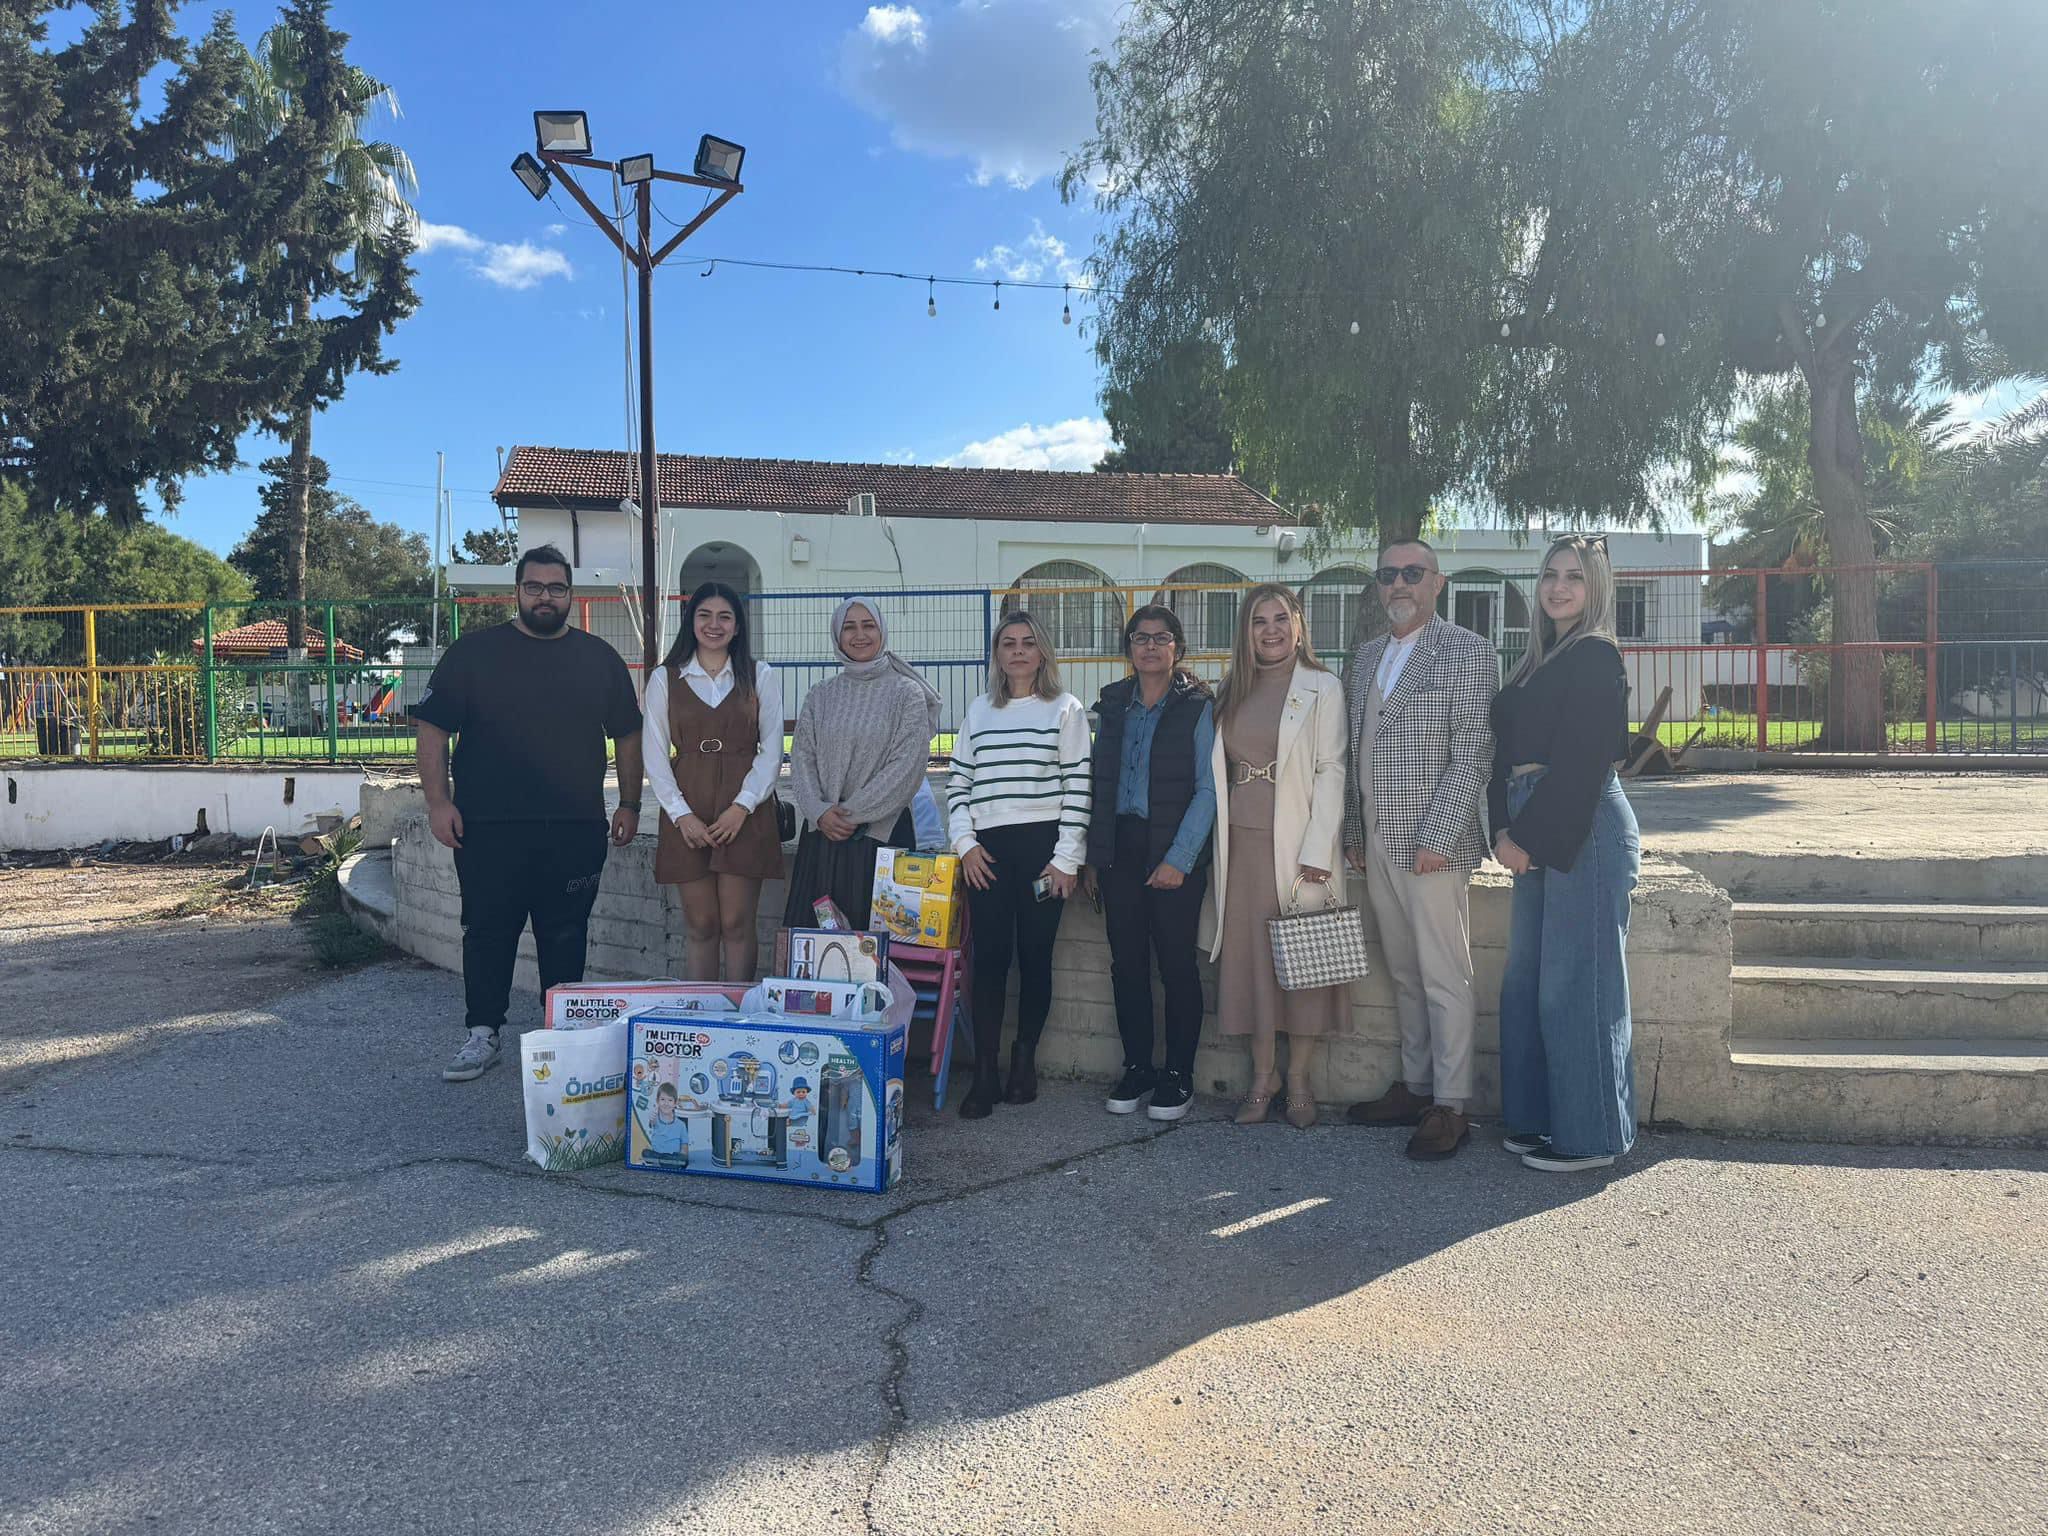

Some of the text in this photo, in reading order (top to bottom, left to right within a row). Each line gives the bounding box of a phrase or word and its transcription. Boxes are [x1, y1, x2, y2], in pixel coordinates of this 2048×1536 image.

[567, 999, 578, 1007] I'M
[581, 999, 613, 1007] LITTLE
[567, 1008, 619, 1018] DOCTOR
[646, 1030, 658, 1039] I'M
[661, 1031, 696, 1042] LITTLE
[646, 1041, 701, 1056] DOCTOR
[831, 1057, 855, 1065] HEALTH
[566, 1073, 625, 1096] Önder
